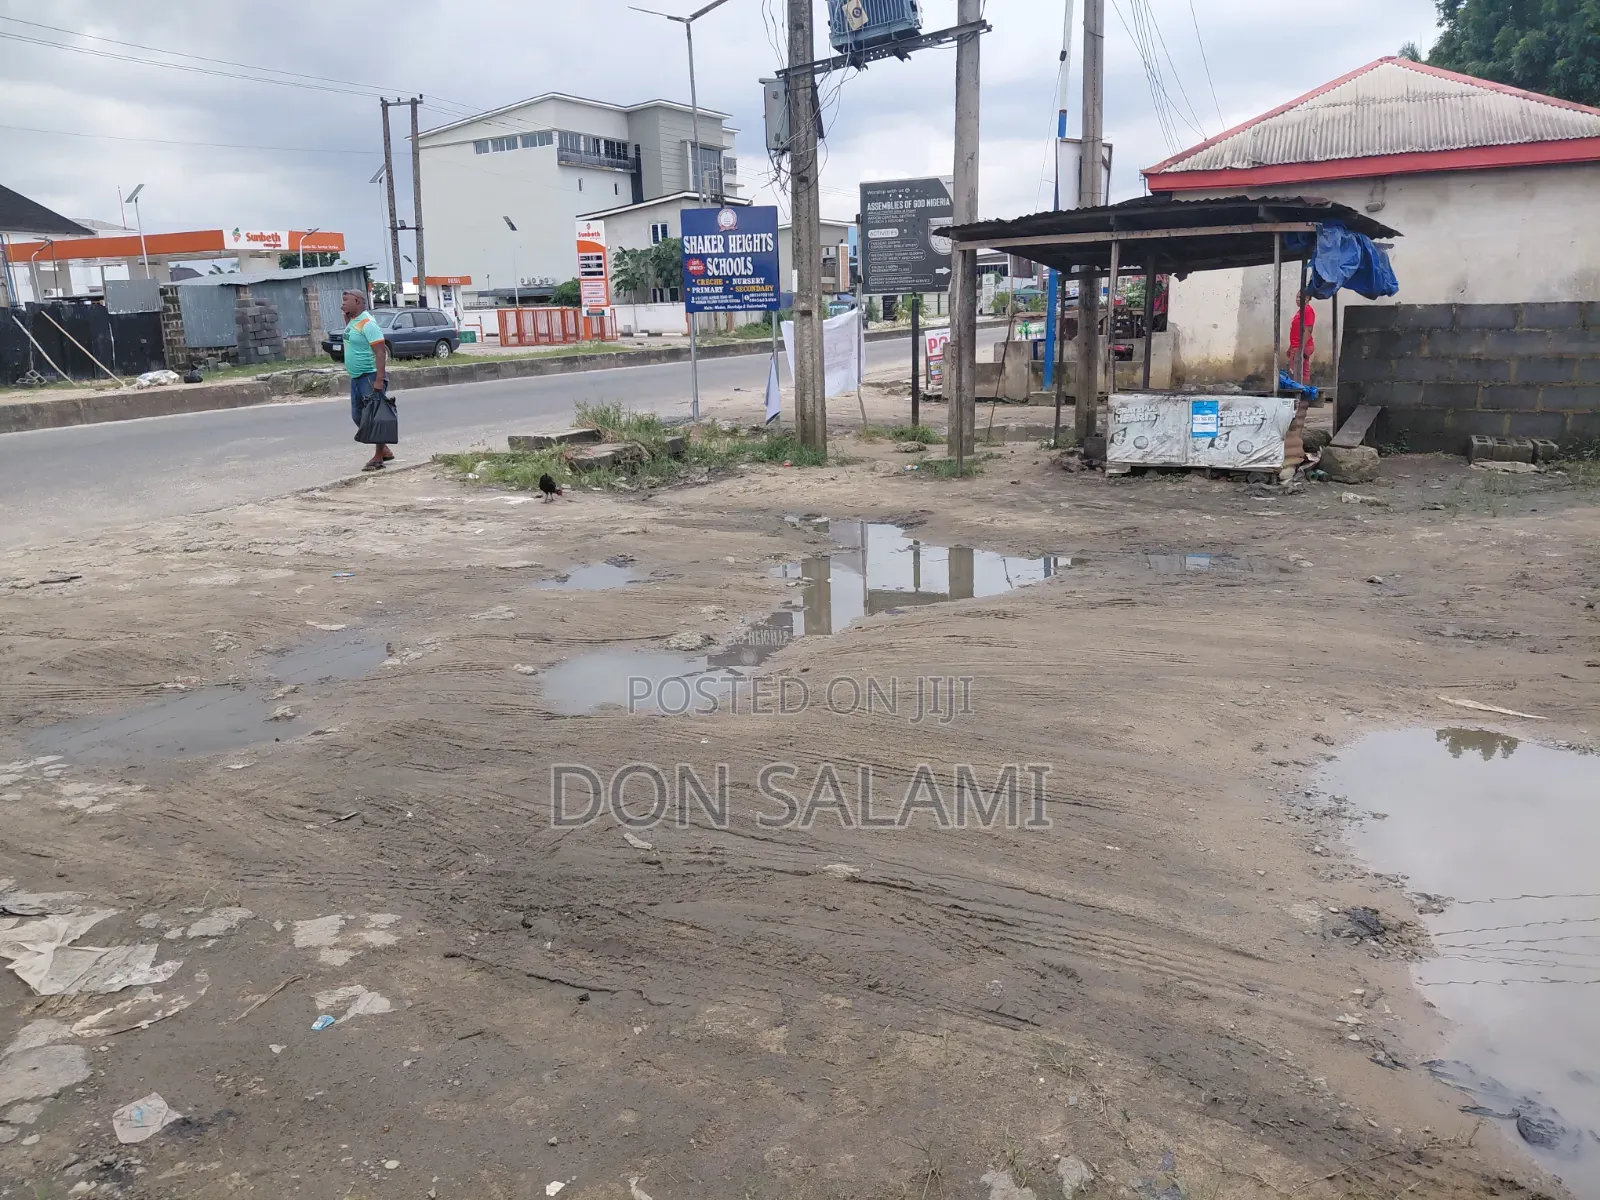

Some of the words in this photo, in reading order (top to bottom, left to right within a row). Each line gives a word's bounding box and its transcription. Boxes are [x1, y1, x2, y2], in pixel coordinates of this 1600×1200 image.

[866, 200, 904, 212] ASSEMBLIES
[904, 199, 912, 209] OF
[913, 199, 926, 208] GOD
[926, 197, 951, 208] NIGERIA
[245, 231, 281, 243] Sunbeth
[869, 229, 898, 237] ACTIVITIES
[683, 234, 725, 254] SHAKER
[728, 232, 774, 253] HEIGHTS
[706, 256, 754, 276] SCHOOLS
[696, 278, 723, 286] CRECHE
[732, 277, 765, 285] NURSERY
[691, 286, 724, 294] PRIMARY
[735, 285, 774, 293] SECONDARY
[928, 335, 949, 354] PO
[1114, 404, 1158, 415] GRATEFUL
[1217, 407, 1265, 418] GRATEFUL
[1114, 411, 1158, 424] HEARTS
[1217, 416, 1264, 427] HEARTS
